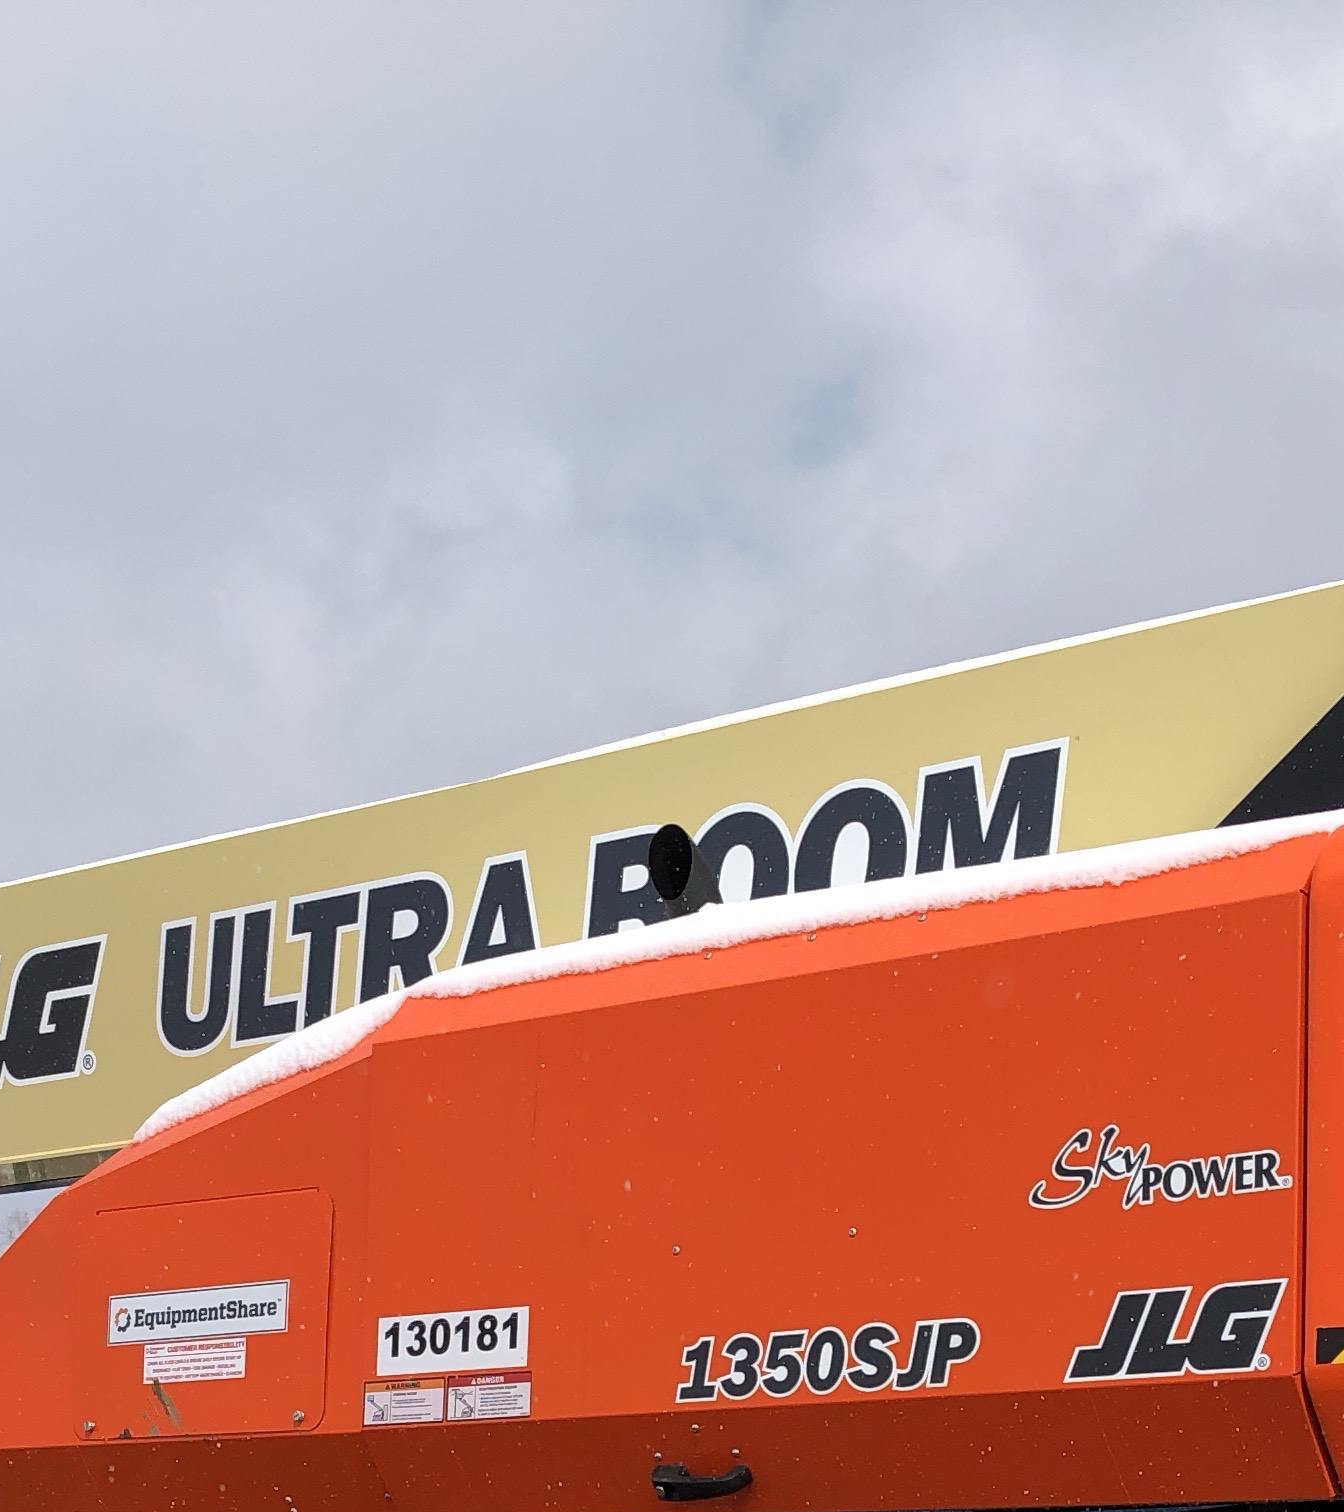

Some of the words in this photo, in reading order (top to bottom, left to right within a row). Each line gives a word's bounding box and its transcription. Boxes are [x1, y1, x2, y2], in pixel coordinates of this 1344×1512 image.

[159, 855, 538, 1056] ULTRA
[586, 745, 1064, 940] BOOM
[133, 1301, 278, 1330] EquipmentShare
[384, 1311, 519, 1358] 130181
[1065, 1280, 1287, 1381] JLG
[677, 1319, 980, 1403] 1350SJP
